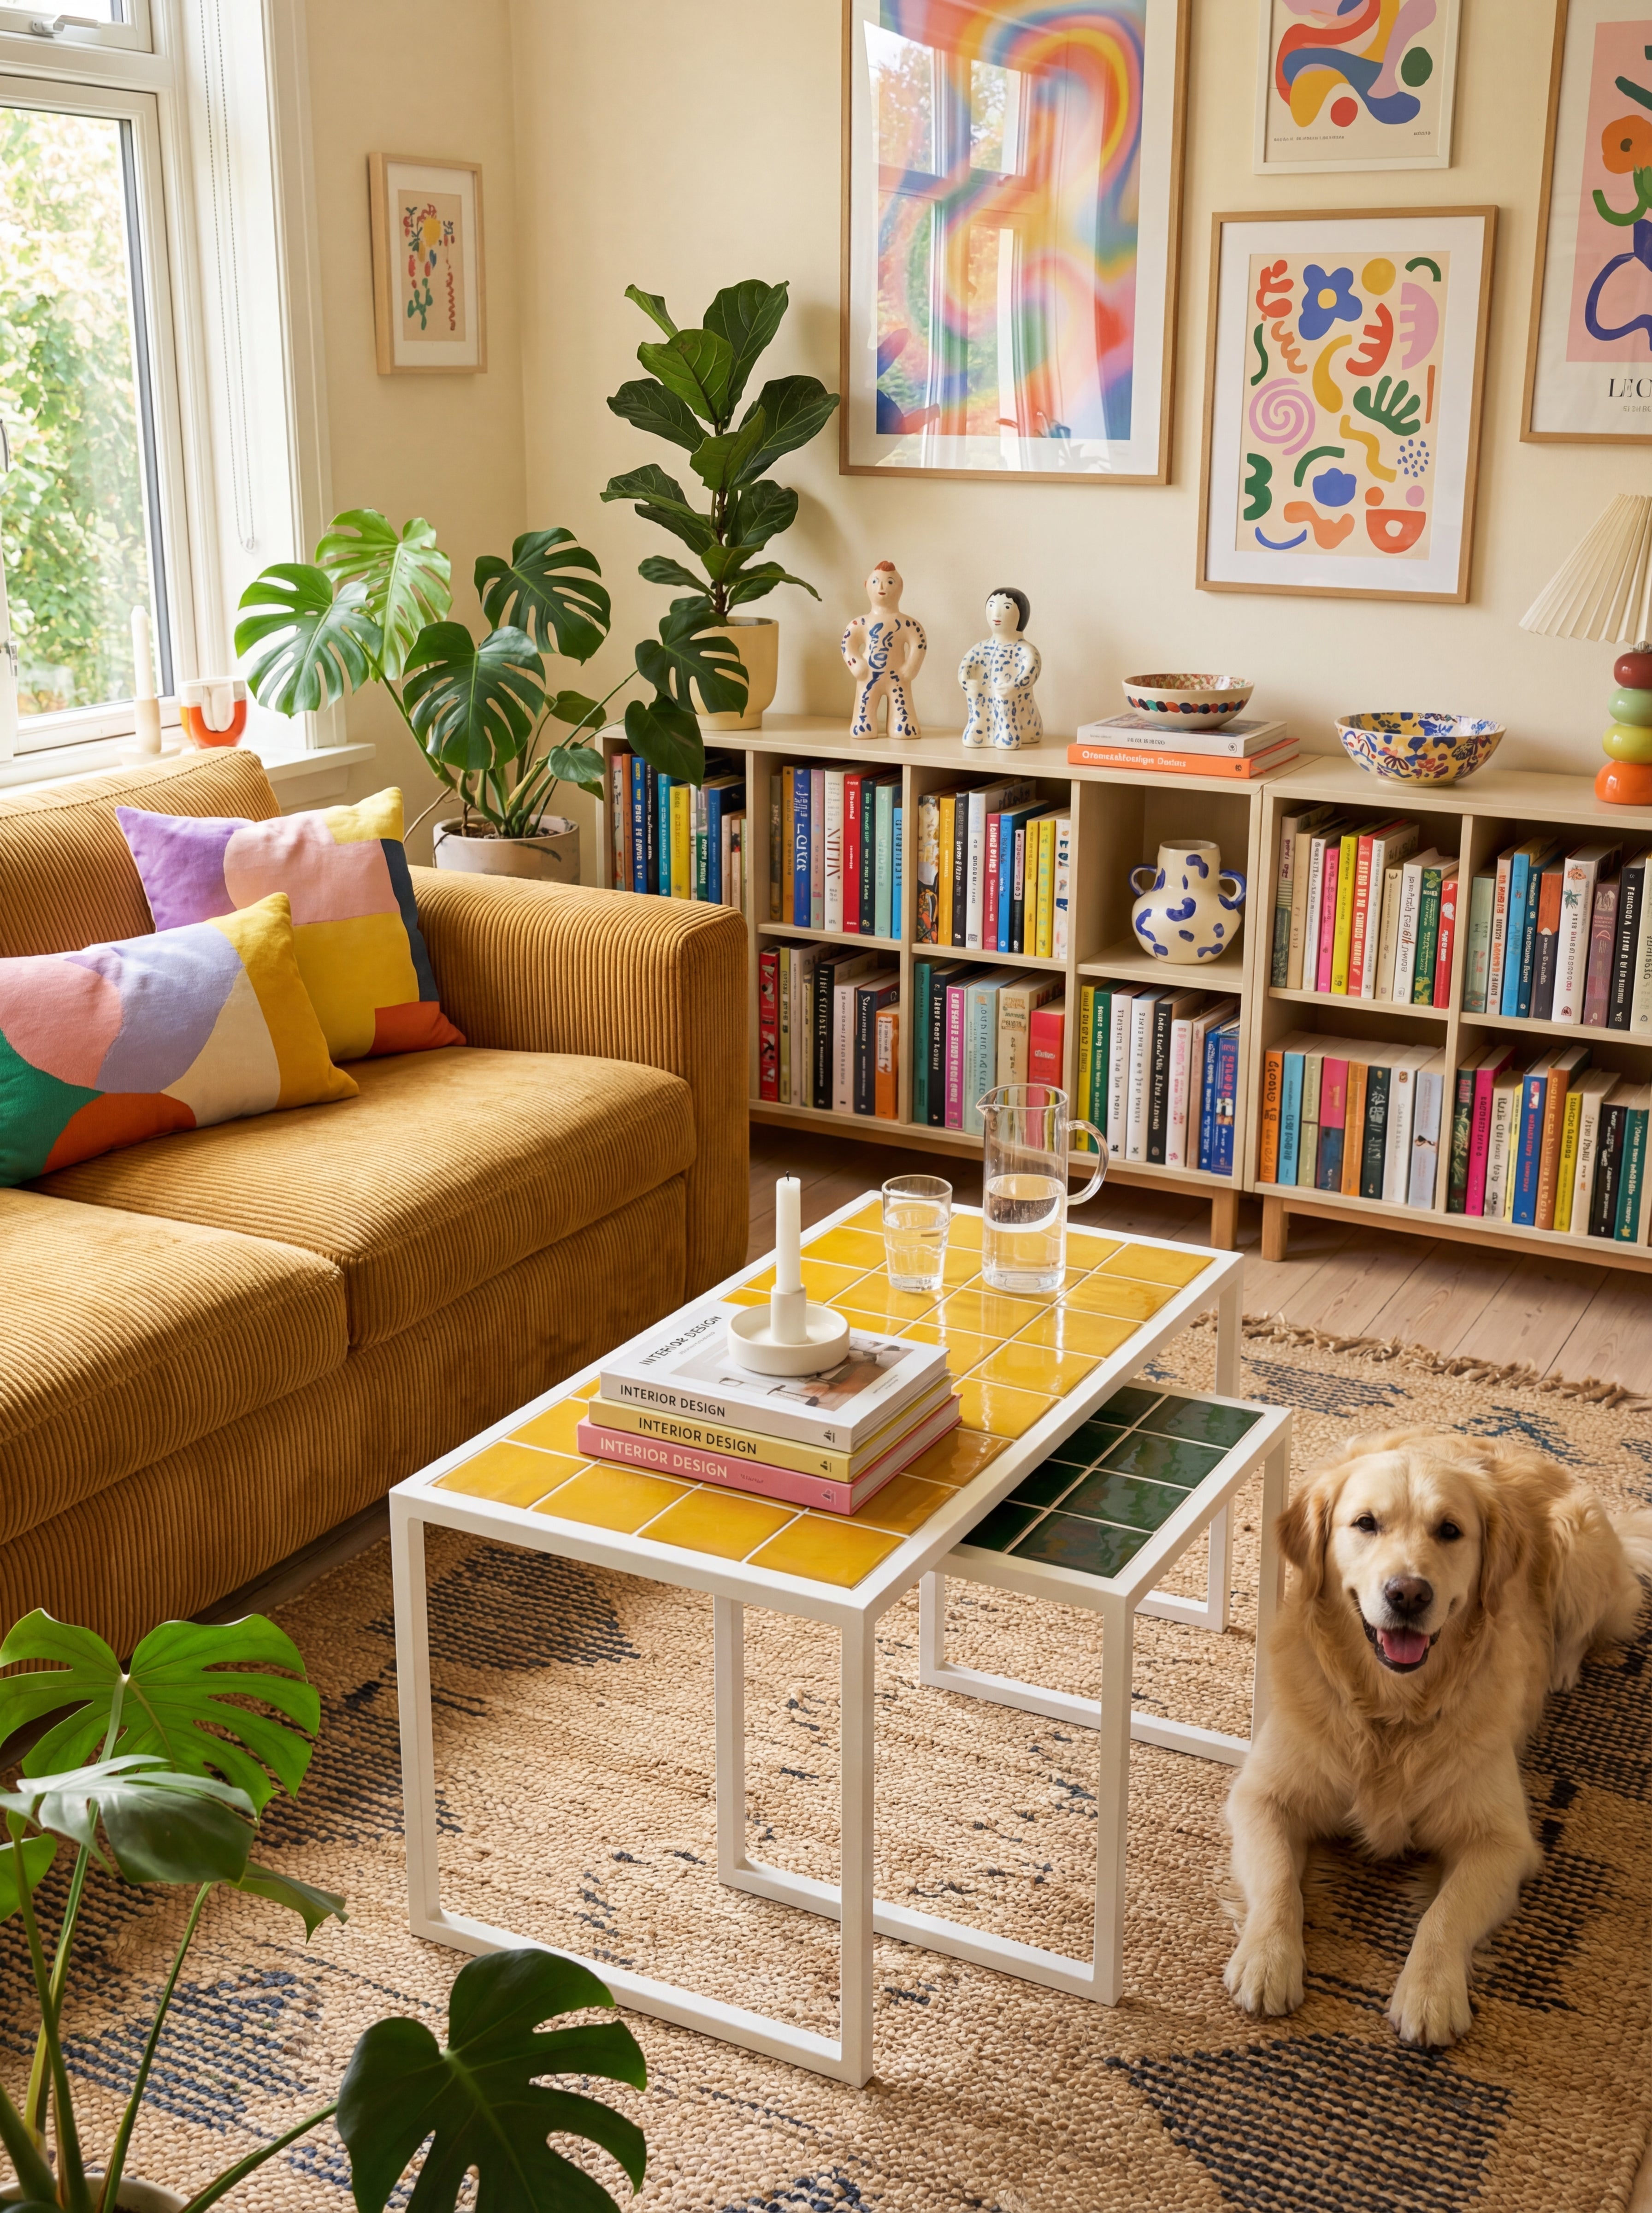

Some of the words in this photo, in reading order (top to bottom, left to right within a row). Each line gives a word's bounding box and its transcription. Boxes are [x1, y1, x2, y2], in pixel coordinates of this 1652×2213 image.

[639, 1337, 688, 1365] INTERIOR
[684, 1316, 722, 1337] DESIGN
[621, 1385, 676, 1406] INTERIOR
[681, 1398, 725, 1417] DESIGN
[639, 1417, 701, 1442] INTERIOR
[707, 1433, 756, 1455] DESIGN
[601, 1437, 667, 1465] INTERIOR
[673, 1454, 727, 1479] DESIGN
